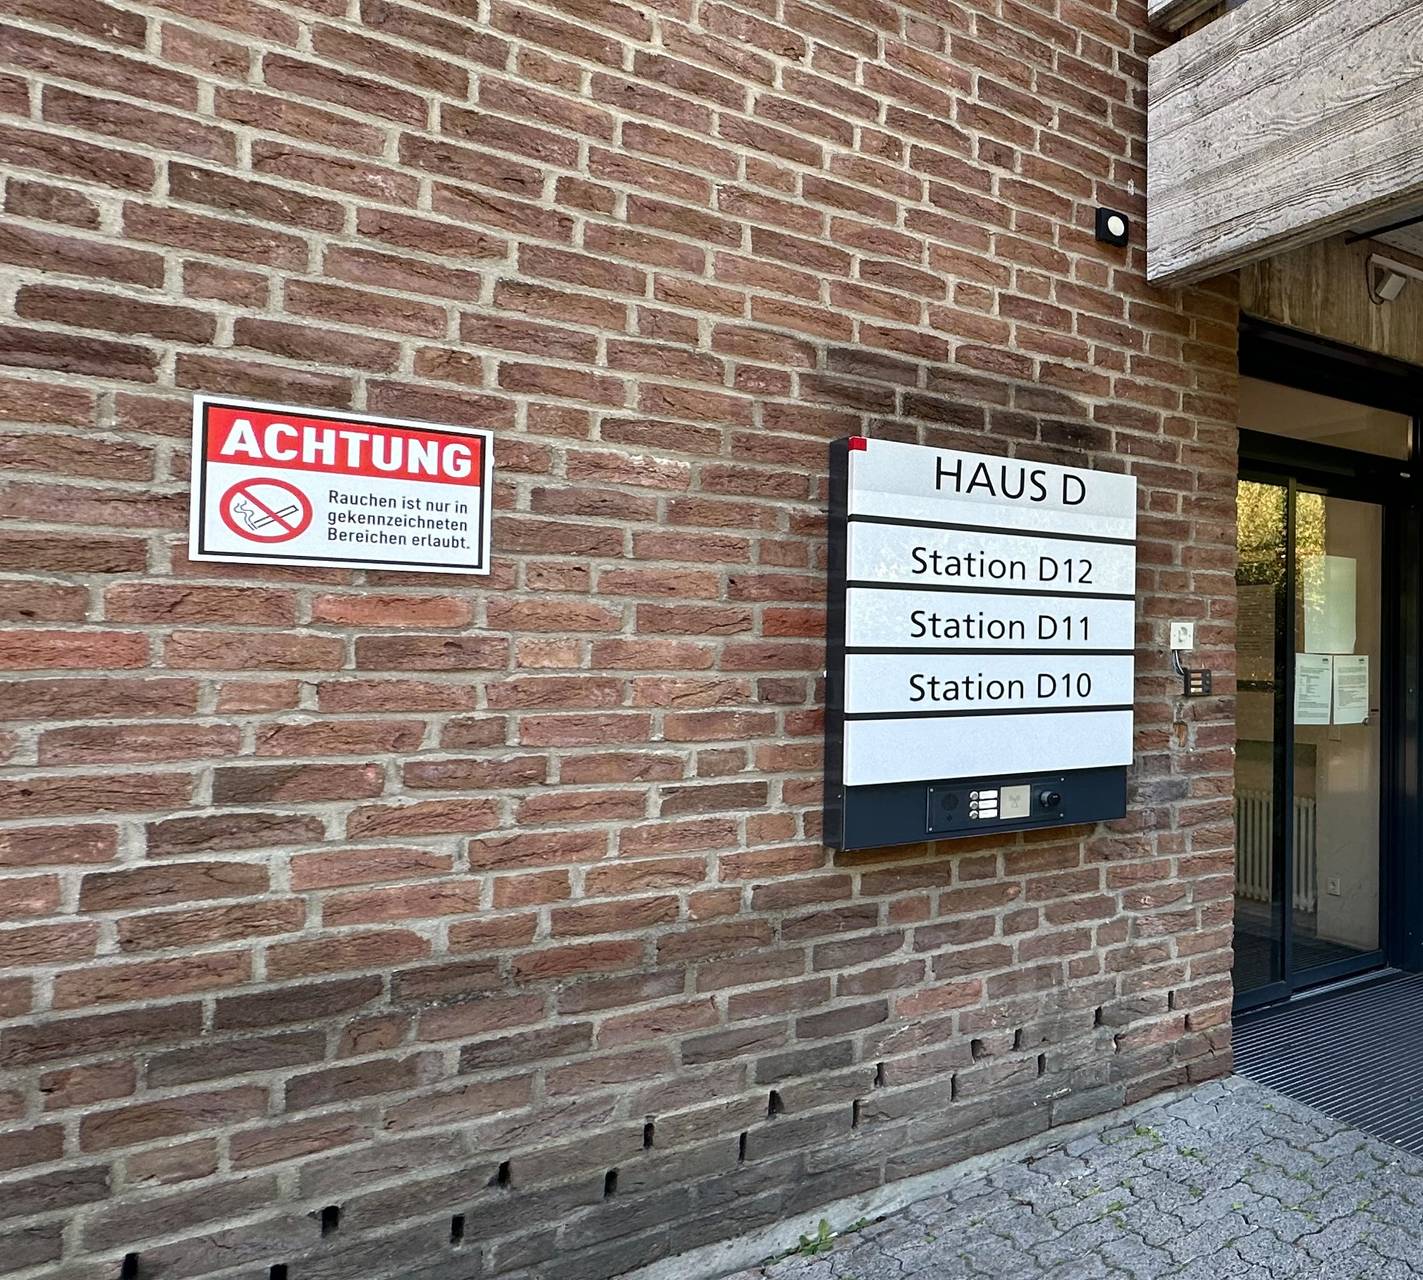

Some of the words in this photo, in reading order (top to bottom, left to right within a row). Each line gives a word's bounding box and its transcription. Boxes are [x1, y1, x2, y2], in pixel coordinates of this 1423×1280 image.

[220, 419, 472, 478] ACHTUNG
[935, 456, 1047, 502] HAUS
[1062, 474, 1086, 505] D
[328, 490, 397, 509] Rauchen
[402, 497, 421, 511] ist
[426, 502, 451, 513] nur
[455, 501, 467, 514] in
[328, 510, 467, 531] gekennzeichneten
[328, 528, 407, 545] Bereichen
[411, 534, 470, 549] erlaubt.
[911, 546, 1026, 581] Station
[1039, 557, 1093, 584] D12
[910, 610, 1025, 640] Station
[1038, 615, 1090, 641] D11
[909, 673, 1024, 702] Station
[1037, 673, 1092, 698] D10
